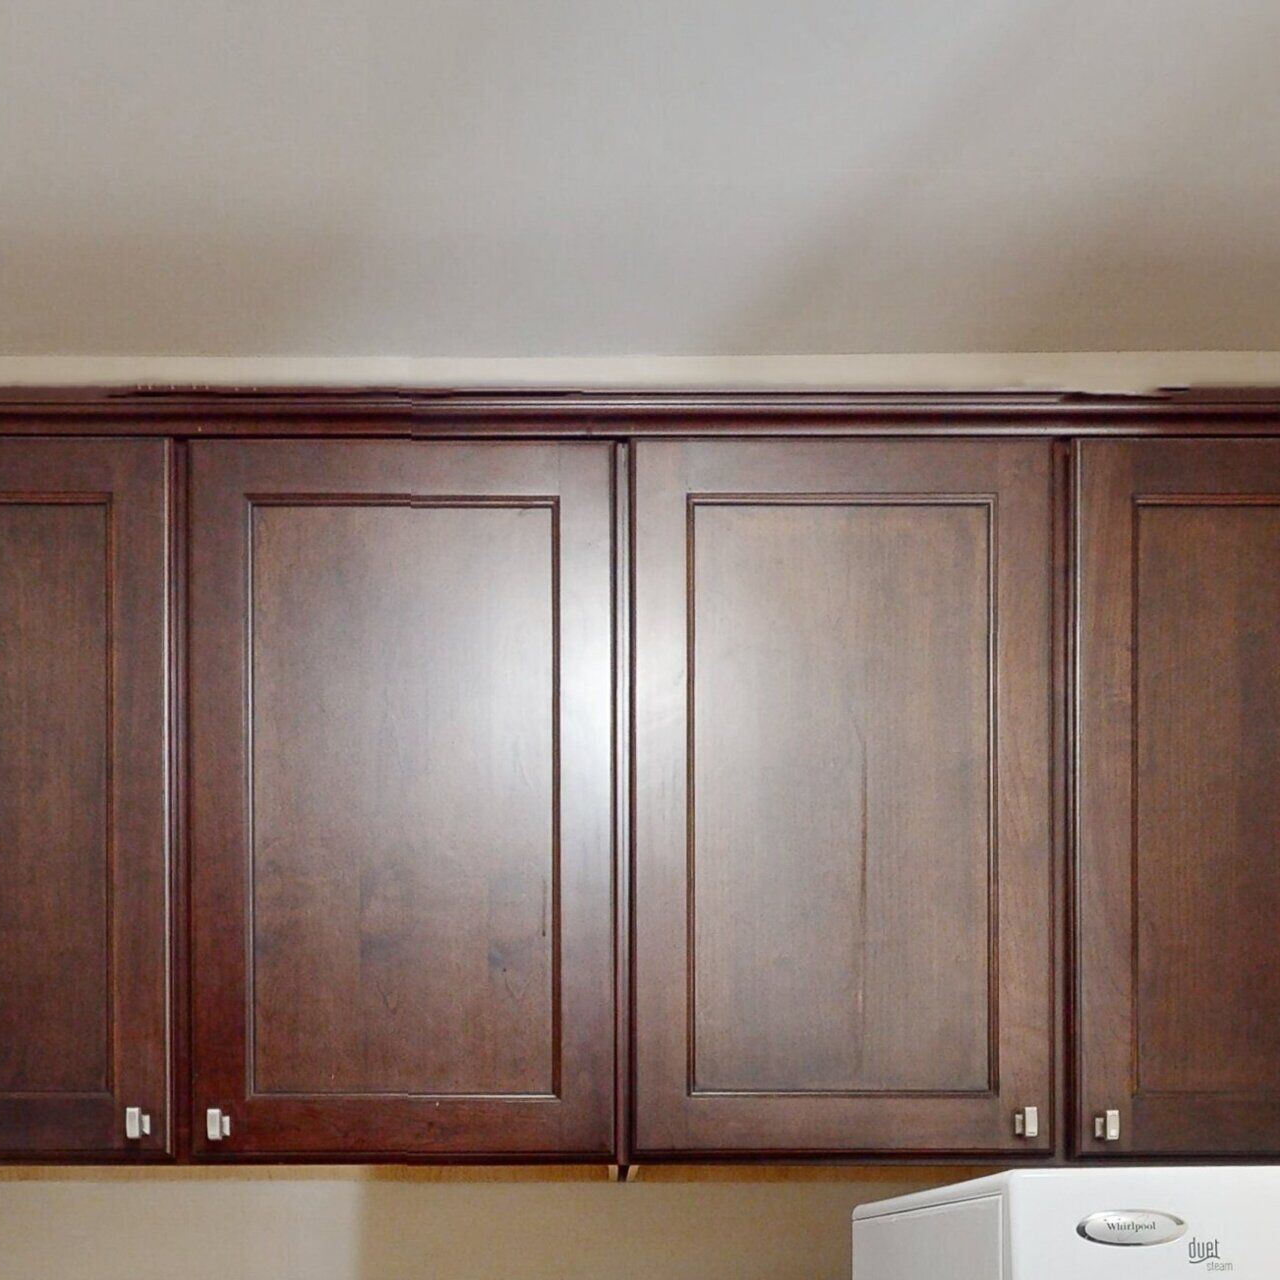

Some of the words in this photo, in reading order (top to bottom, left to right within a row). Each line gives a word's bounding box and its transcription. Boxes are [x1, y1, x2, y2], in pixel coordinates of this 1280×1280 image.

[1106, 1220, 1157, 1233] Whirlpool
[1188, 1237, 1220, 1262] duet
[1206, 1261, 1234, 1272] steam
